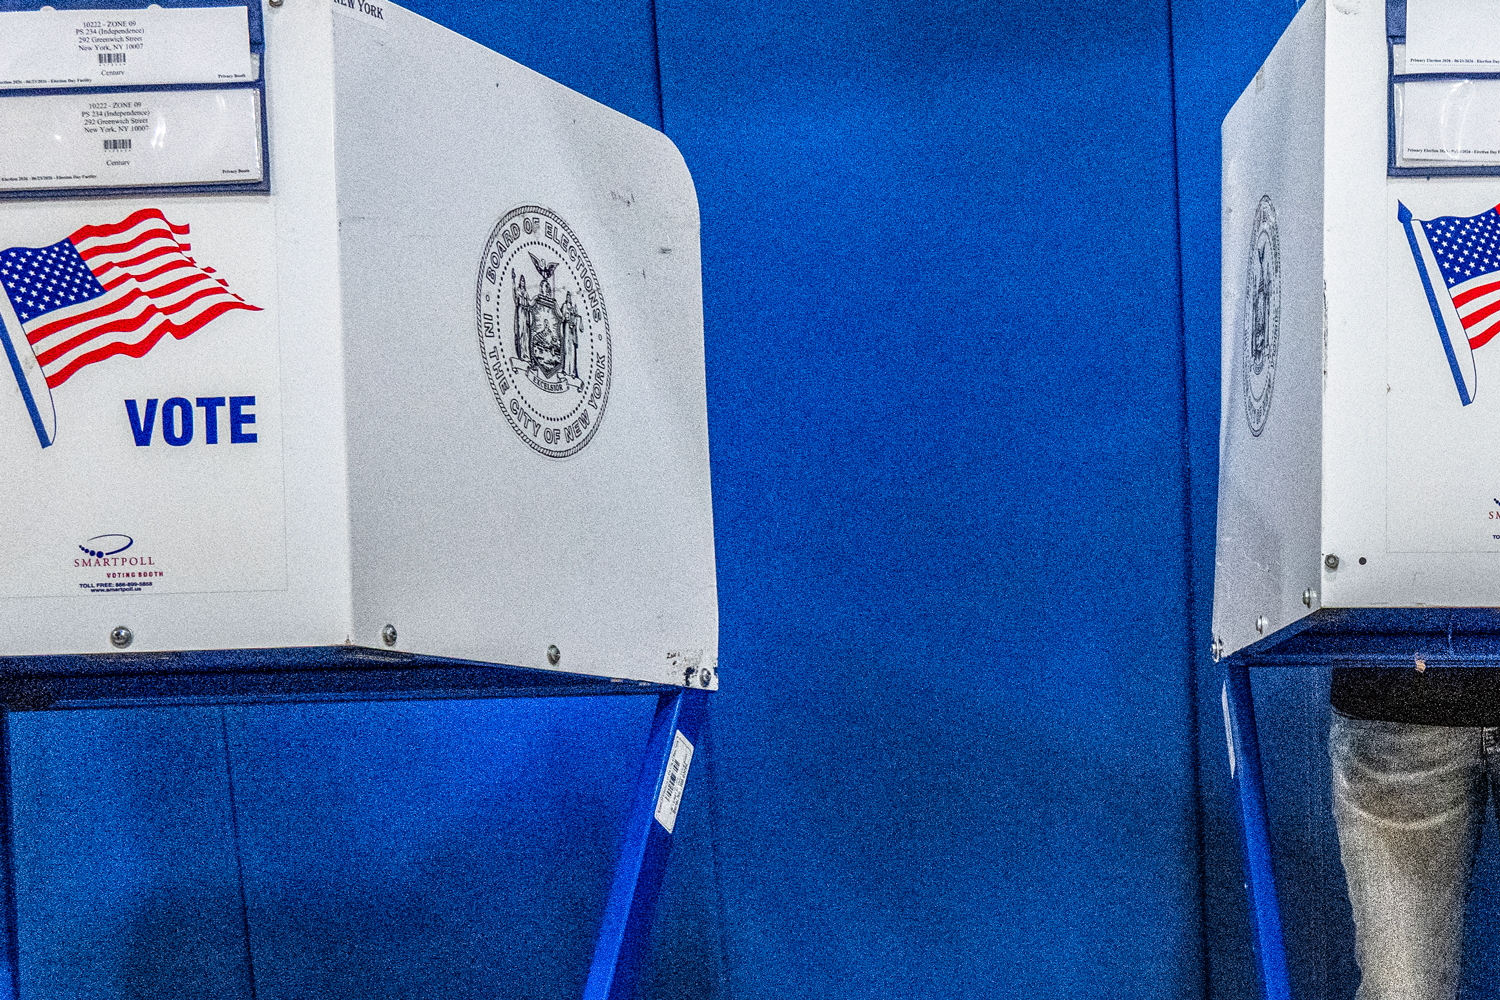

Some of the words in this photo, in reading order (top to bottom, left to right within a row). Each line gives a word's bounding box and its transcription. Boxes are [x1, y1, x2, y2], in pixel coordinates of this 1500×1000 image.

[104, 110, 150, 118] (Independence)
[486, 223, 521, 285] BOARD
[545, 221, 602, 323] ELECTIONS
[484, 313, 494, 338] IN
[489, 346, 510, 395] THE
[509, 398, 541, 437] CITY
[544, 427, 560, 444] OF
[564, 409, 591, 443] NEW
[588, 352, 605, 410] YORK
[533, 376, 563, 392] EXCELSIOR
[124, 395, 258, 447] VOTE
[74, 556, 155, 567] SMARTPOLL
